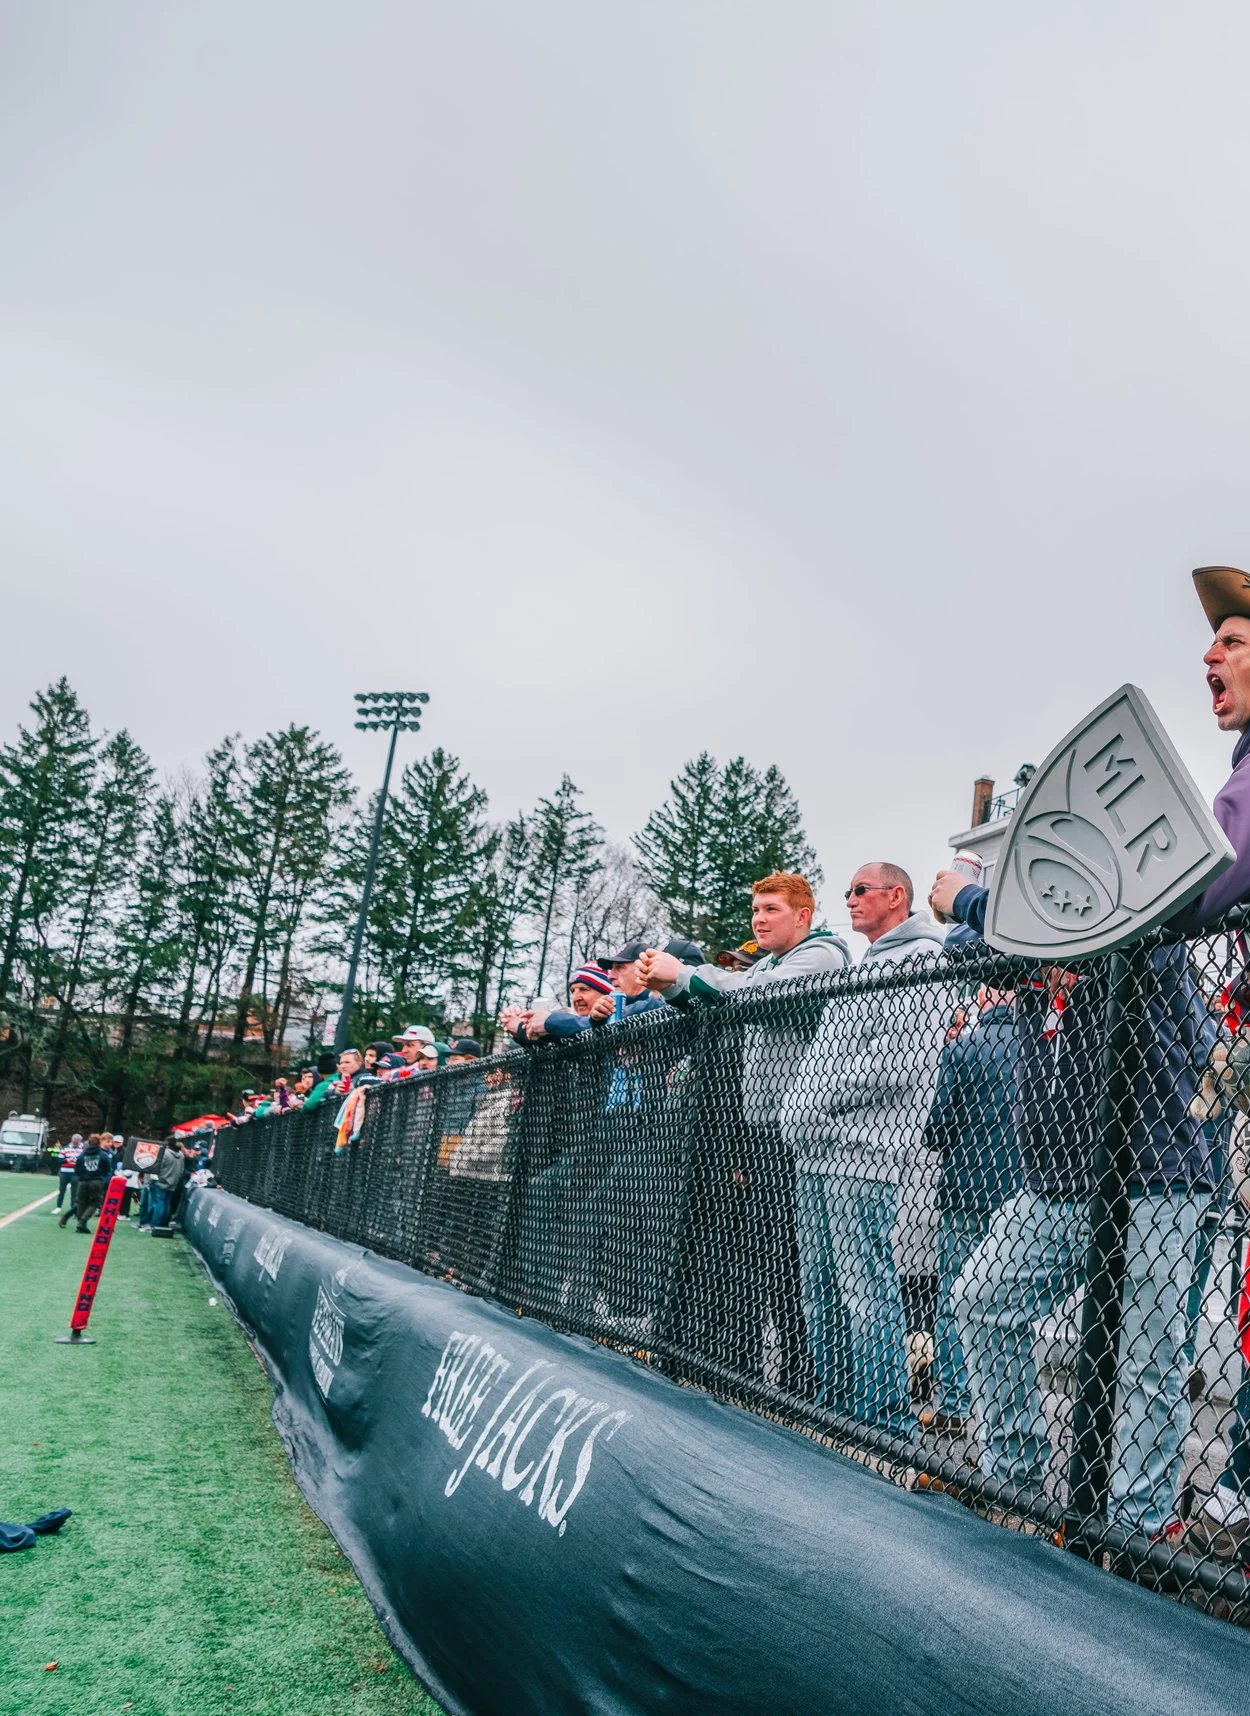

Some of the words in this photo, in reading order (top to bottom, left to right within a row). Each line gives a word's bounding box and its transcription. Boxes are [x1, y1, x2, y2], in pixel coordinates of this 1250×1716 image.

[1083, 733, 1178, 876] MLR
[96, 1198, 118, 1244] RHINO
[77, 1264, 99, 1312] RHINO
[421, 1331, 511, 1451] FREE
[444, 1358, 634, 1527] JACKS
